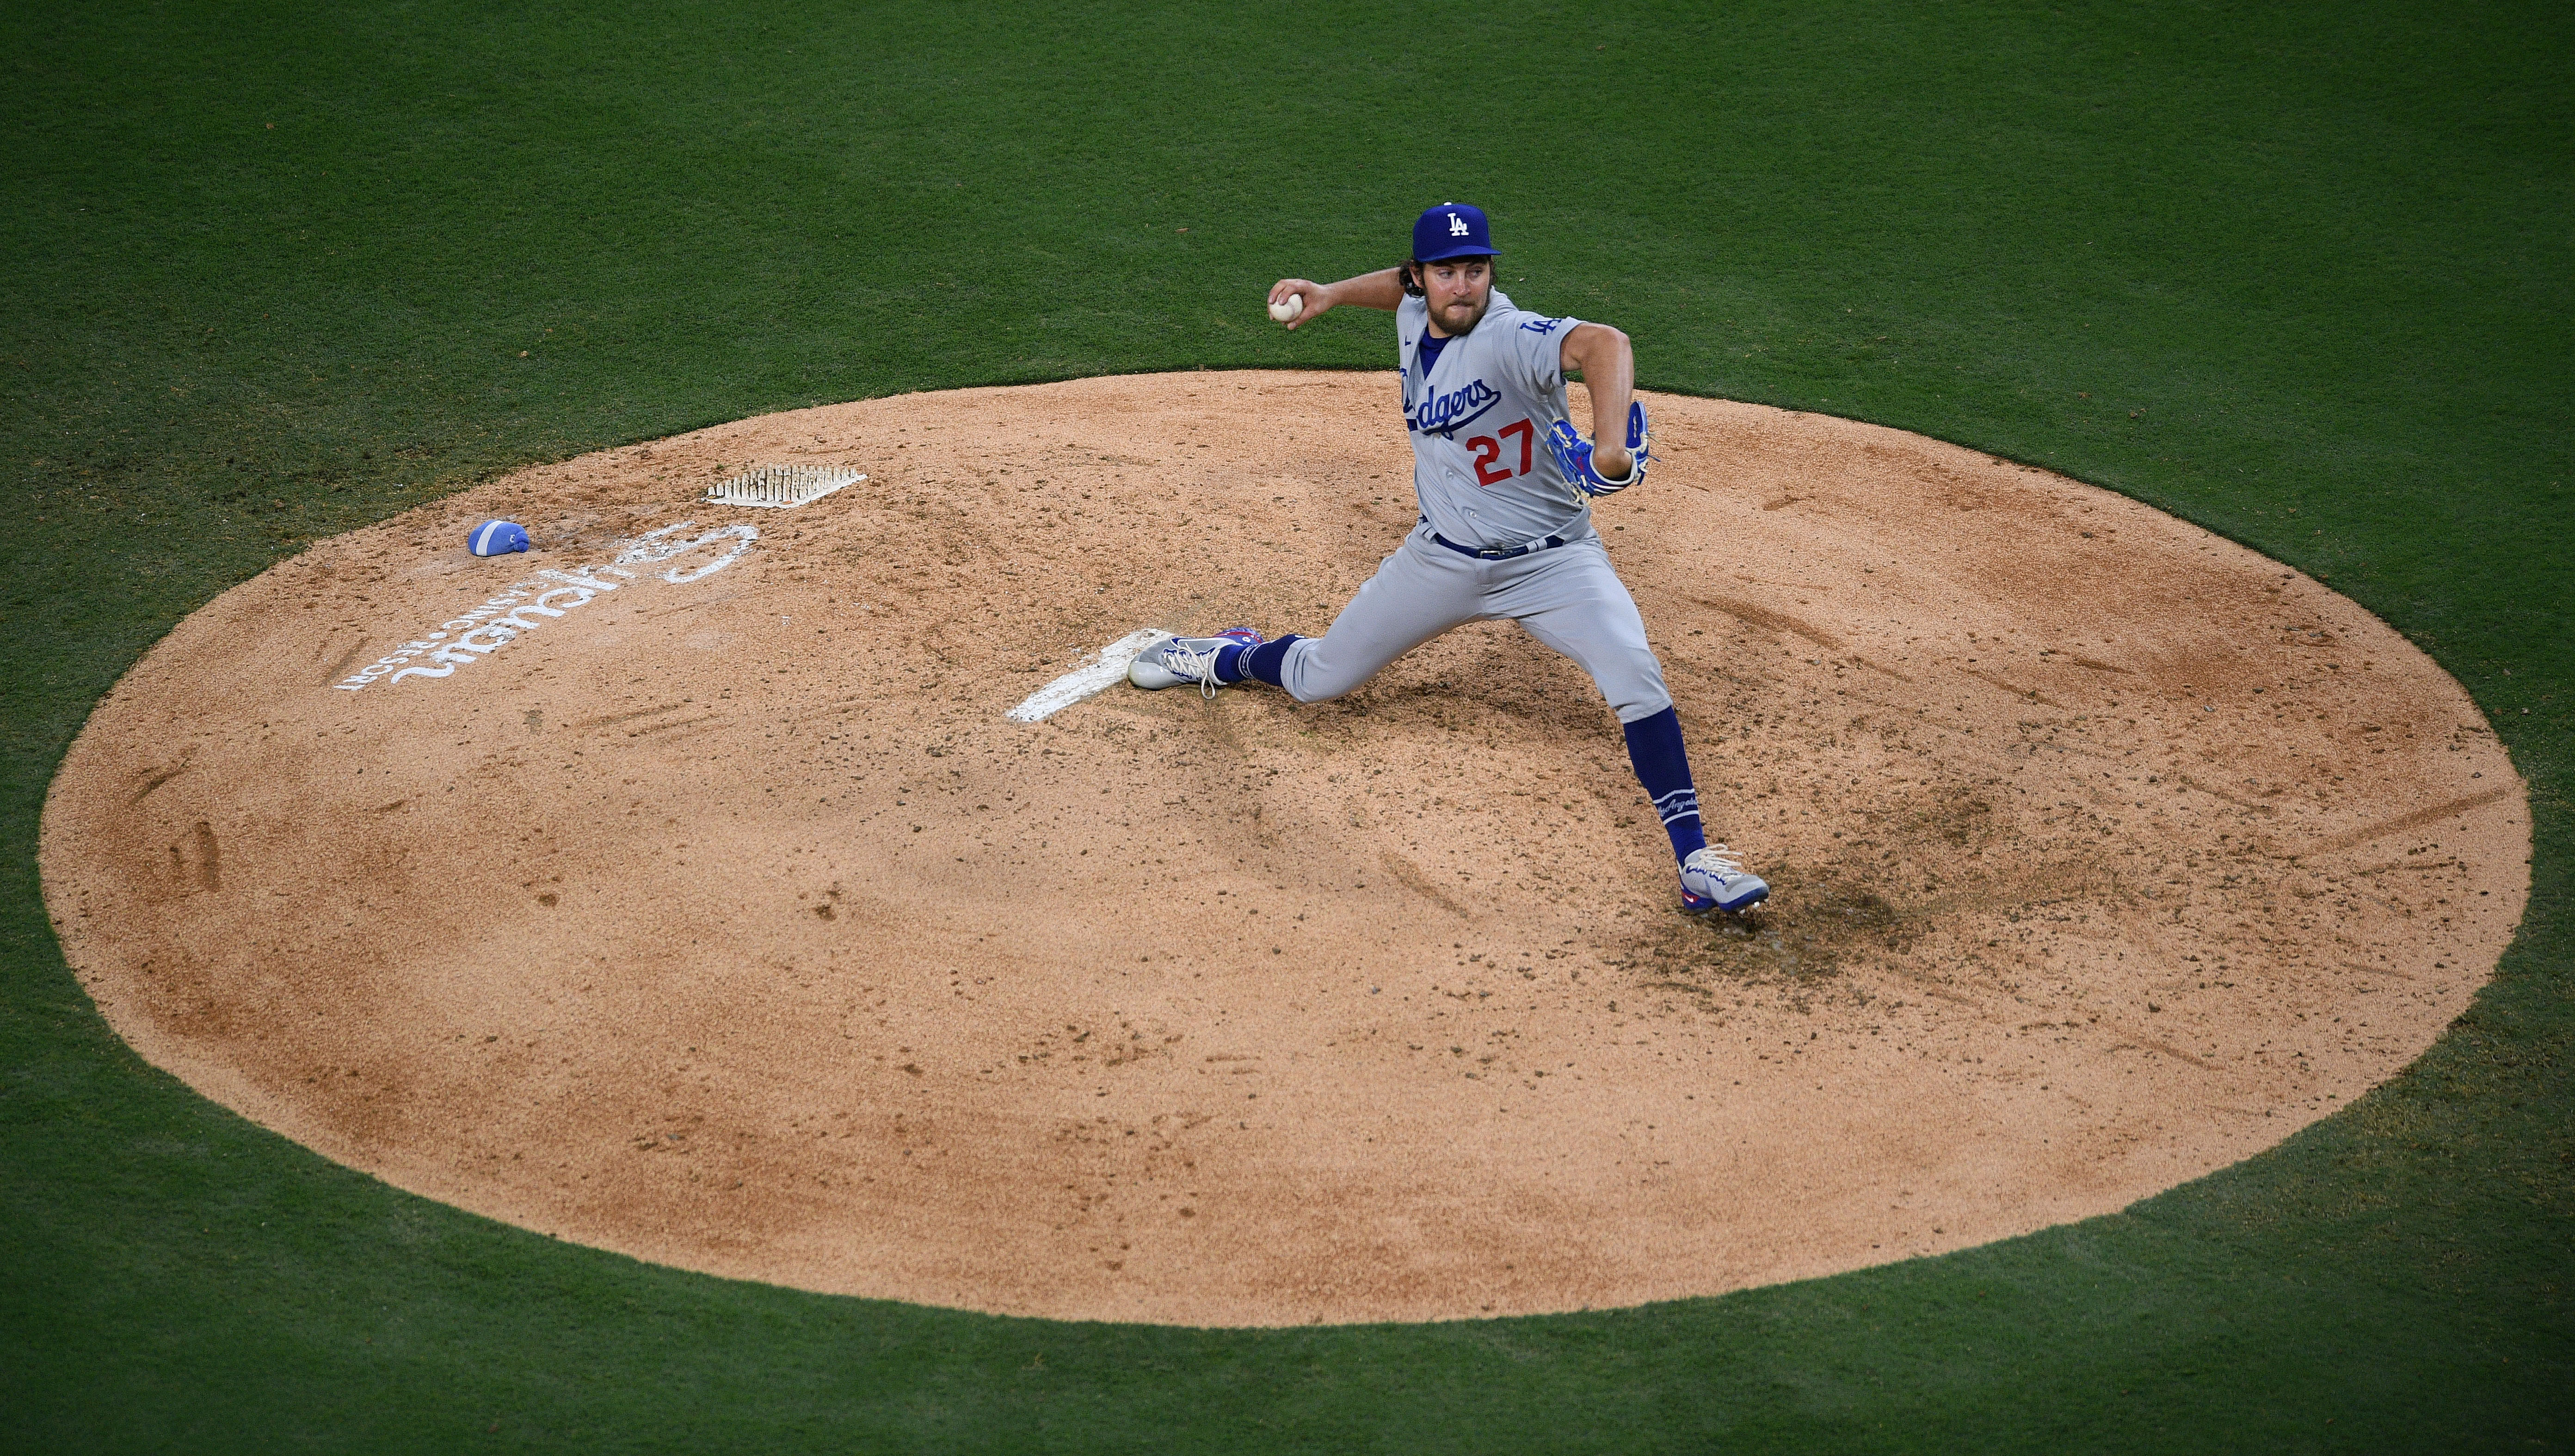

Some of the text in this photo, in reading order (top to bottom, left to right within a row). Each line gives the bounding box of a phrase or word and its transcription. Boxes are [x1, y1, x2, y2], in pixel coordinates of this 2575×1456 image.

[1447, 213, 1469, 236] LA
[1519, 318, 1562, 335] LA
[1465, 418, 1534, 487] 27
